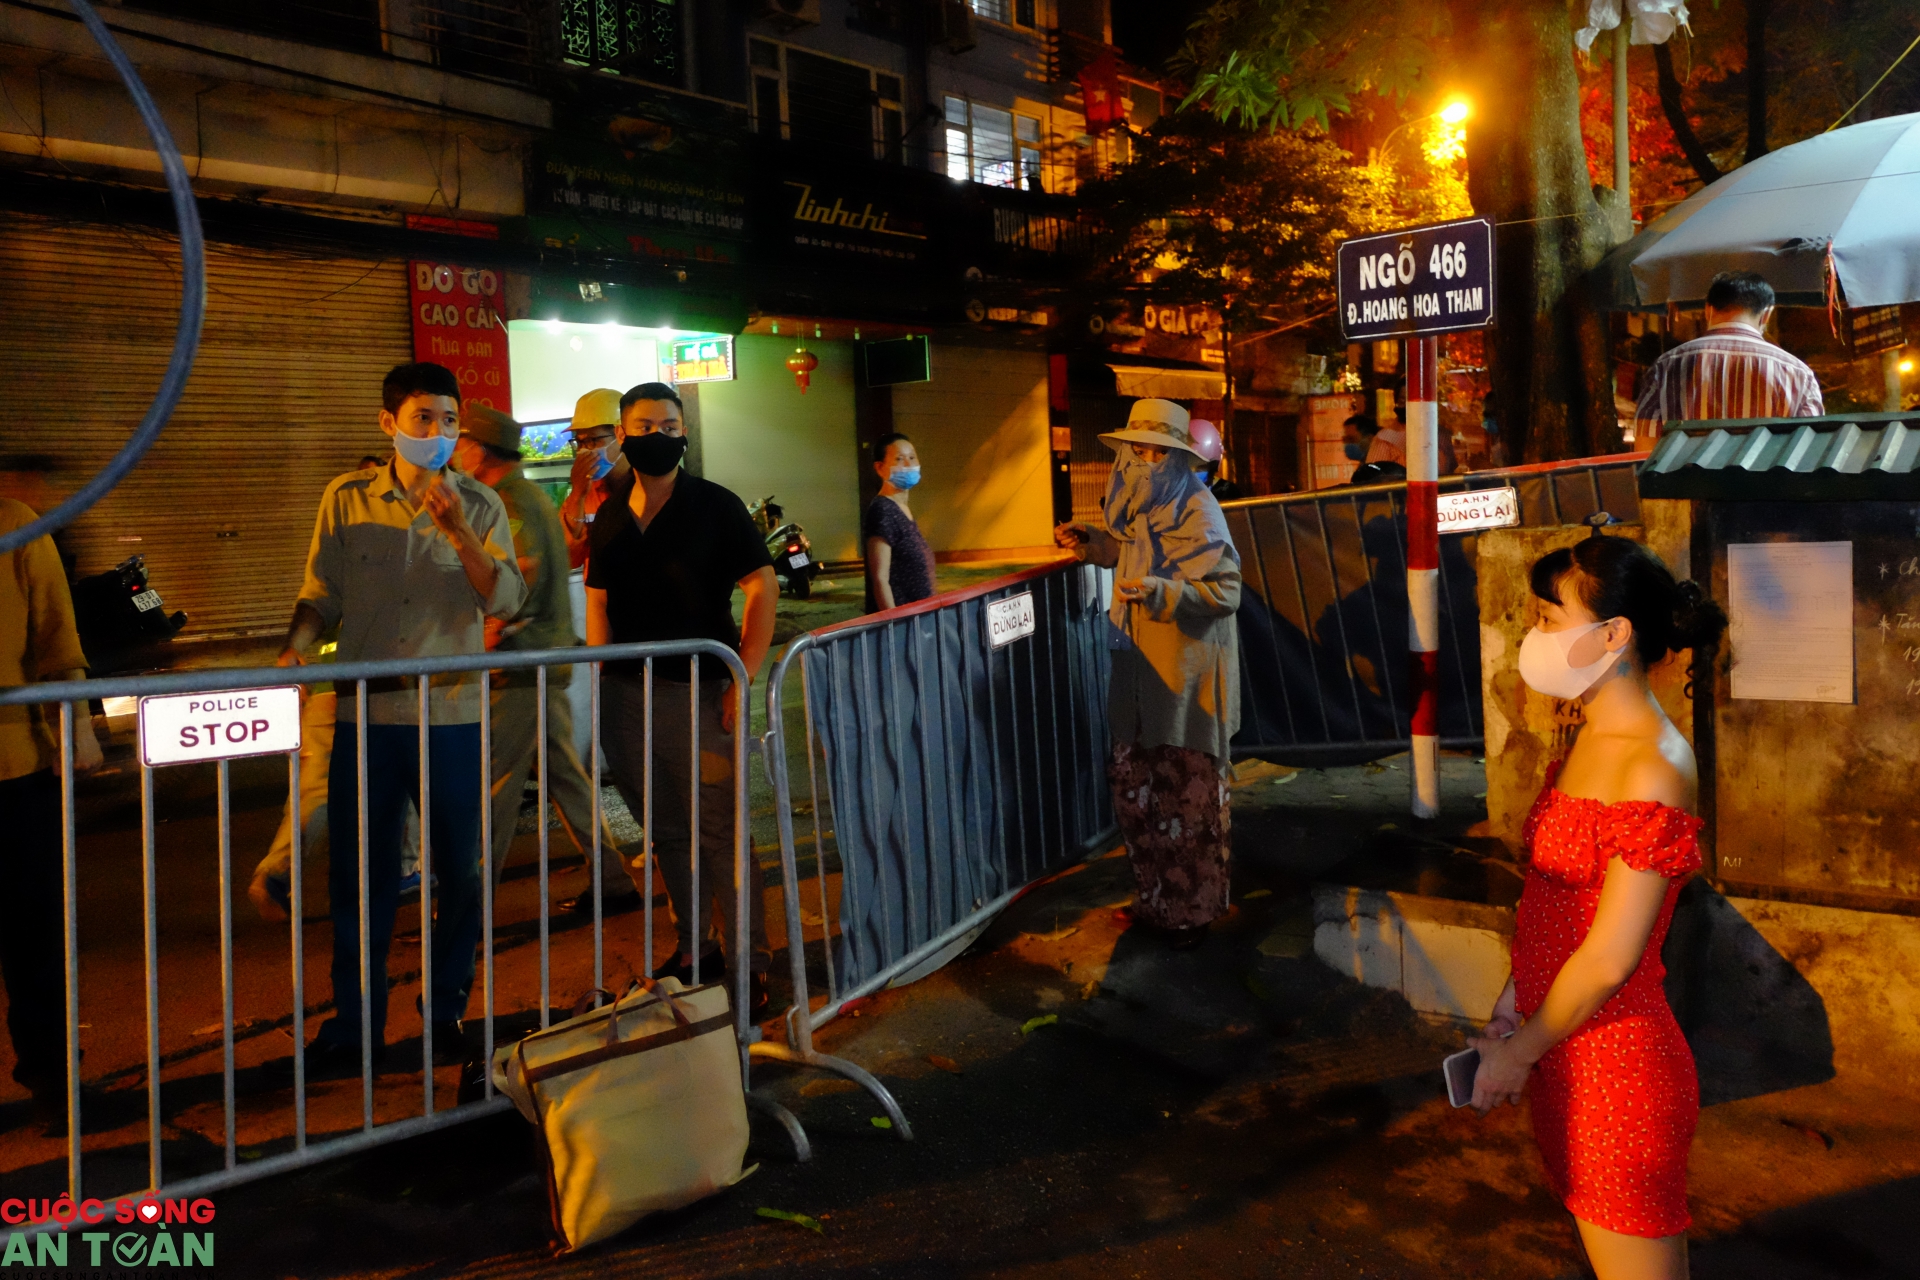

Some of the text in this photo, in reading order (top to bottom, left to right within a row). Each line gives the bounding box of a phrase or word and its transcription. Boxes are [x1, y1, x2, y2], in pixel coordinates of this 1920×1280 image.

[1359, 241, 1467, 291] NGÕ 466
[420, 303, 459, 327] CAO
[1413, 293, 1441, 318] HOA
[1446, 286, 1483, 314] THAM
[189, 696, 258, 714] POLICE
[179, 719, 270, 748] STOP
